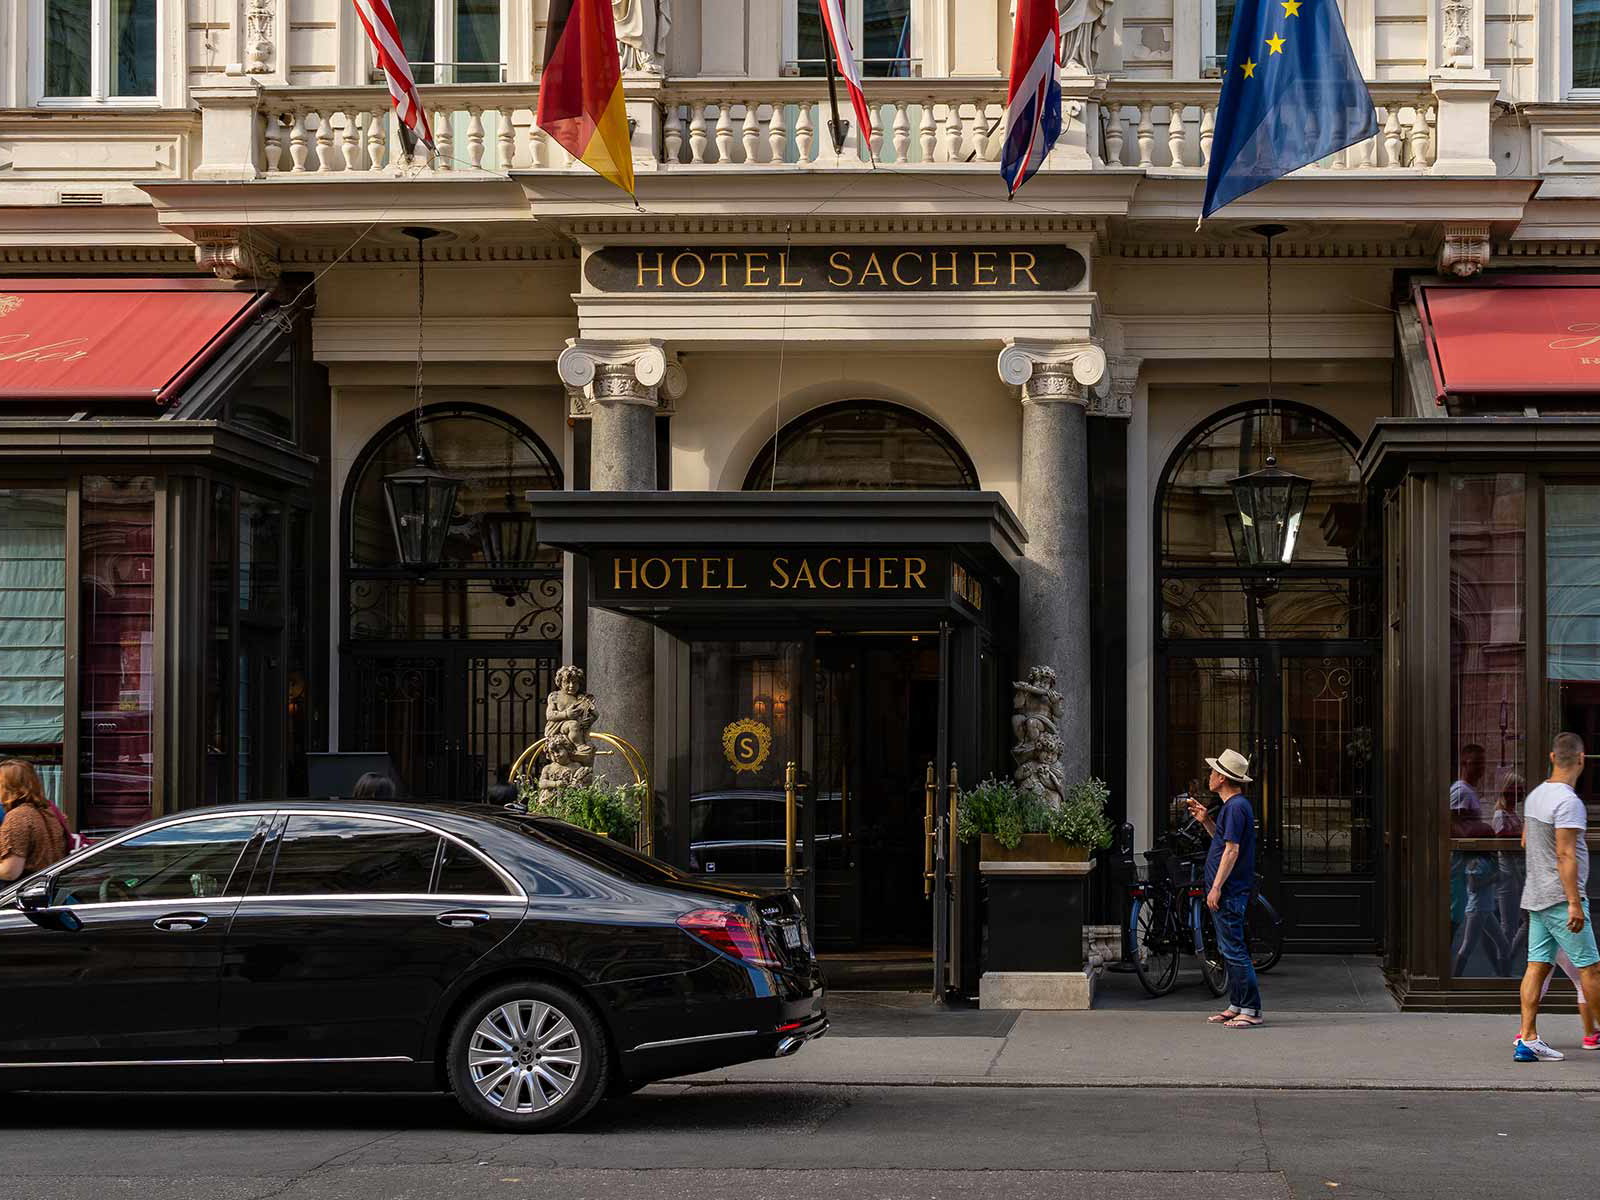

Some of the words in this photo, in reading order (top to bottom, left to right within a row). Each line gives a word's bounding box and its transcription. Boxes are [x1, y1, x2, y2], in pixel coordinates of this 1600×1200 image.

[636, 251, 803, 287] HOTEL
[828, 251, 1040, 287] SACHER
[613, 557, 747, 590] HOTEL
[770, 557, 928, 590] SACHER
[740, 737, 754, 759] S
